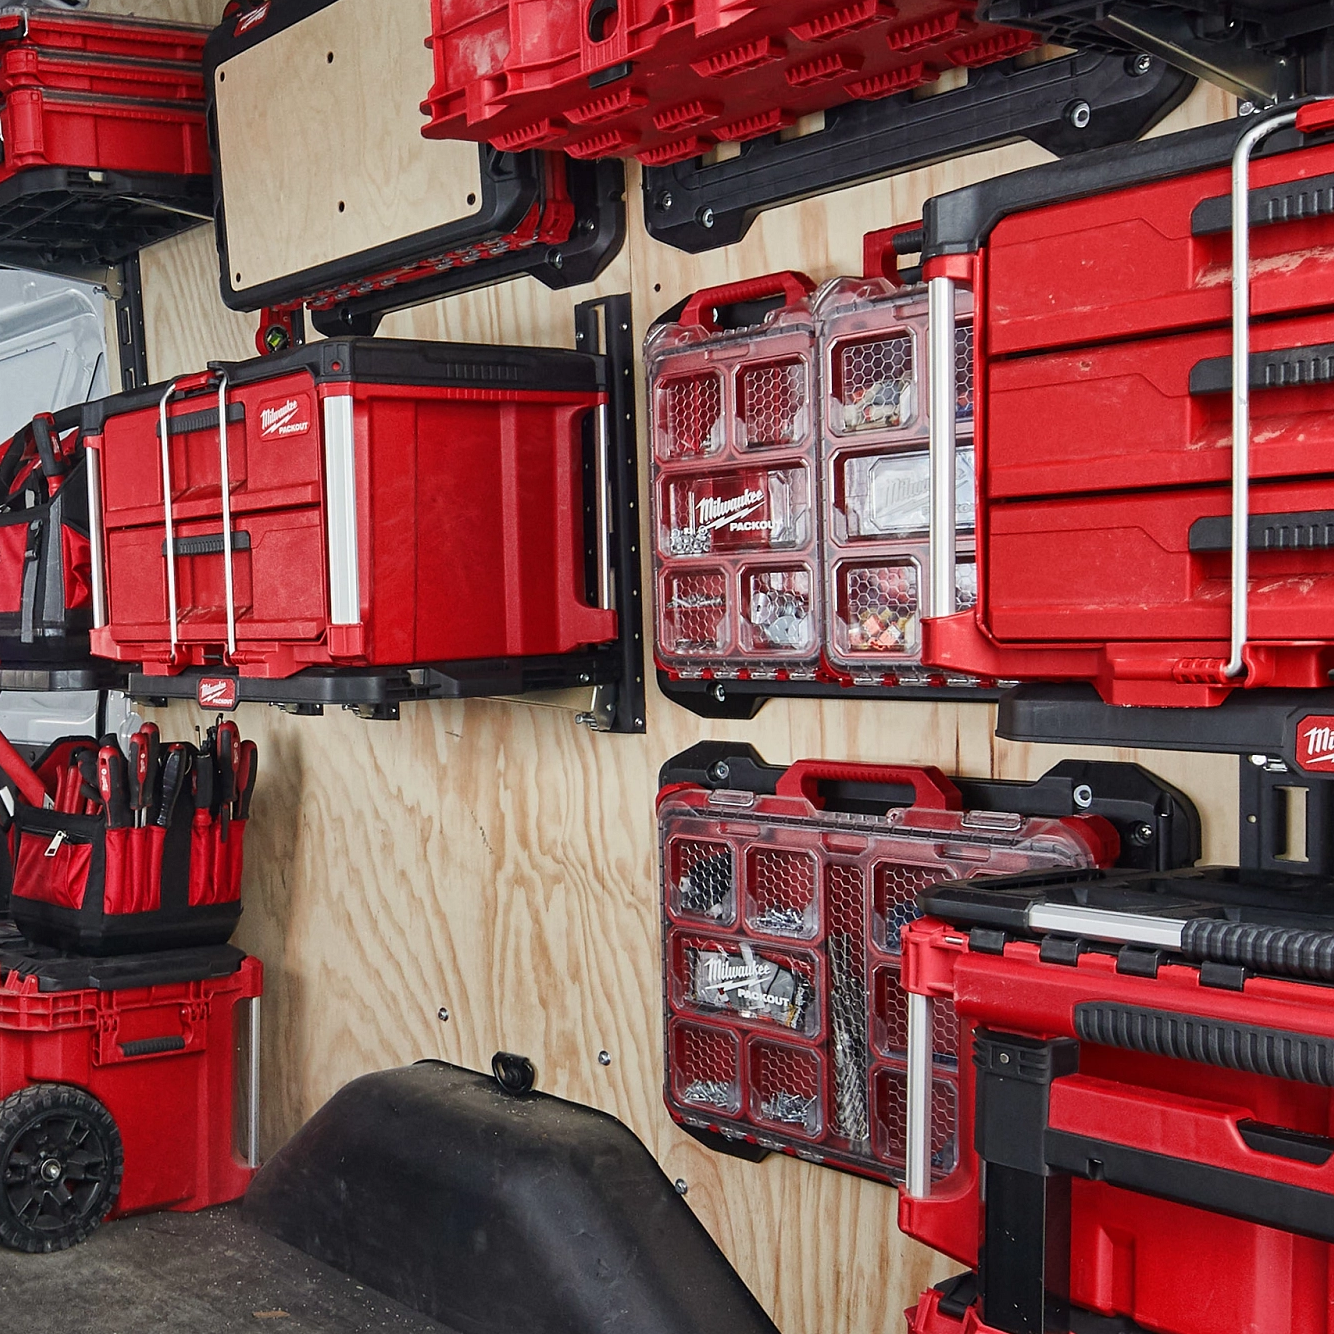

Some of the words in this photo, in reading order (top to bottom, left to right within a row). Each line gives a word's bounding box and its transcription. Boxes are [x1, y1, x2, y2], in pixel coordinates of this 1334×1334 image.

[695, 488, 765, 524] Milwaukee
[704, 958, 771, 982] Milwaukee
[738, 989, 790, 1007] PACKOUT
